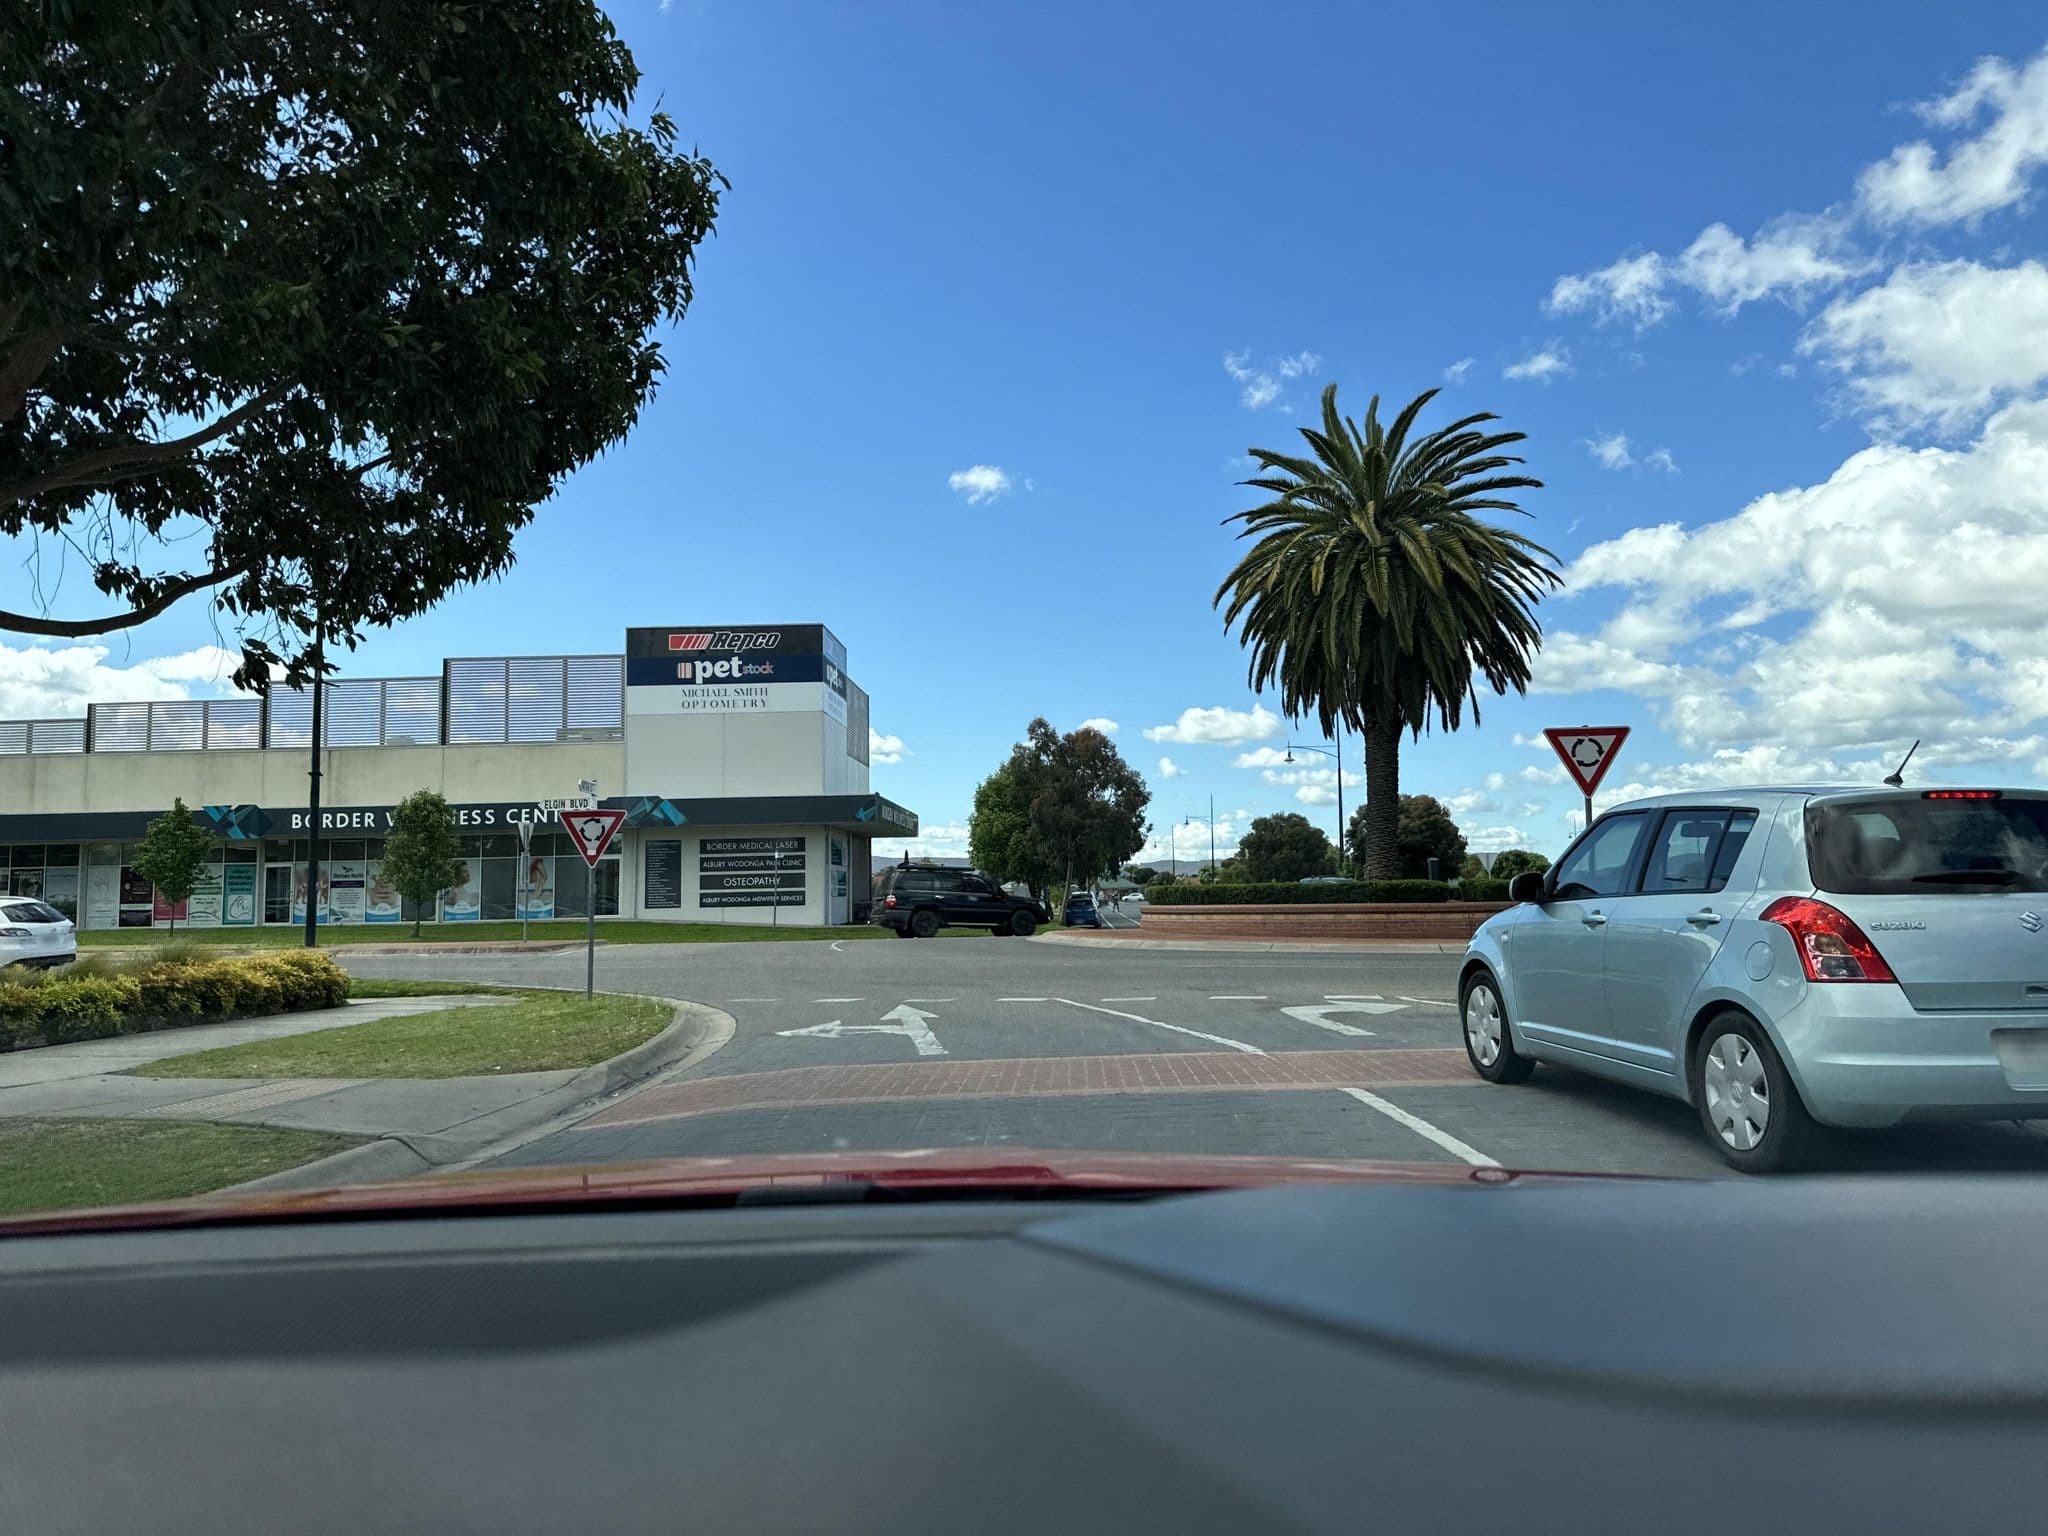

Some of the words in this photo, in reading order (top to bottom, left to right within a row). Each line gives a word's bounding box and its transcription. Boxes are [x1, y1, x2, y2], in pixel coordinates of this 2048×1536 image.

[710, 631, 781, 653] Repco
[682, 688, 732, 698] MICHAEL
[734, 687, 768, 697] SMITH
[682, 699, 768, 709] OPTOMETRY
[544, 799, 566, 810] ELGIN
[569, 798, 589, 809] BLVD
[706, 842, 738, 851] BORDER
[740, 841, 773, 850] MEDICAL
[775, 840, 799, 849] LASER
[727, 860, 765, 868] WODONGA
[781, 858, 803, 867] CLINIC
[723, 876, 781, 887] OSTEOPATHY
[1870, 921, 1926, 931] SUZUKI
